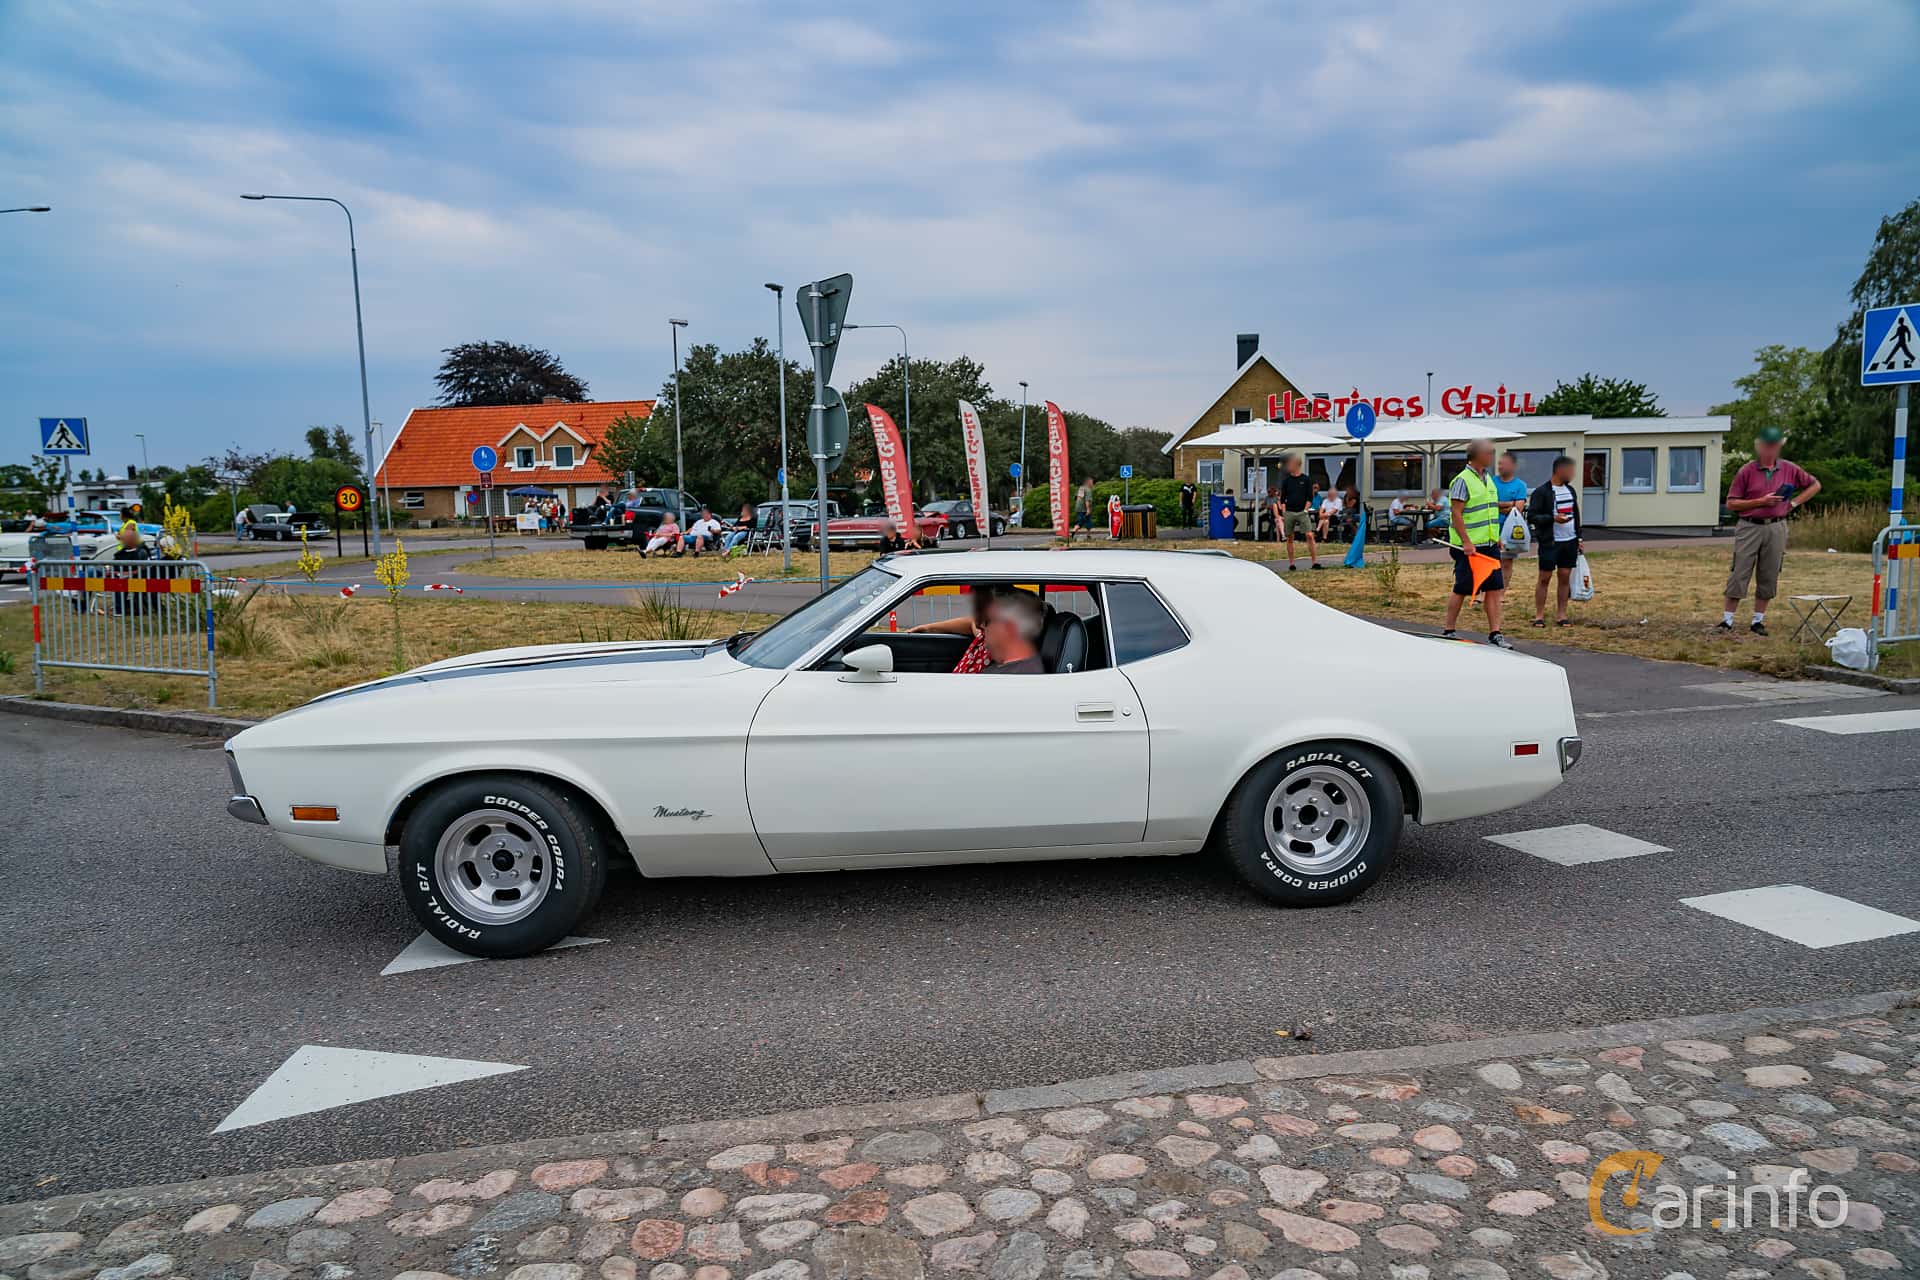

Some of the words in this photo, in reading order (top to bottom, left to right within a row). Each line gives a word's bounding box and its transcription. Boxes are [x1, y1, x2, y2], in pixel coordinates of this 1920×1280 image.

[341, 493, 357, 504] 30
[1285, 752, 1344, 771] RADIAL
[1347, 760, 1373, 779] G/T
[653, 805, 712, 821] Mustang
[484, 795, 550, 831] COOPER
[547, 834, 566, 891] COBRA
[416, 863, 431, 892] G/T
[1260, 850, 1303, 889] COBRA
[1308, 861, 1368, 890] COOPER
[427, 895, 482, 940] RADIAL
